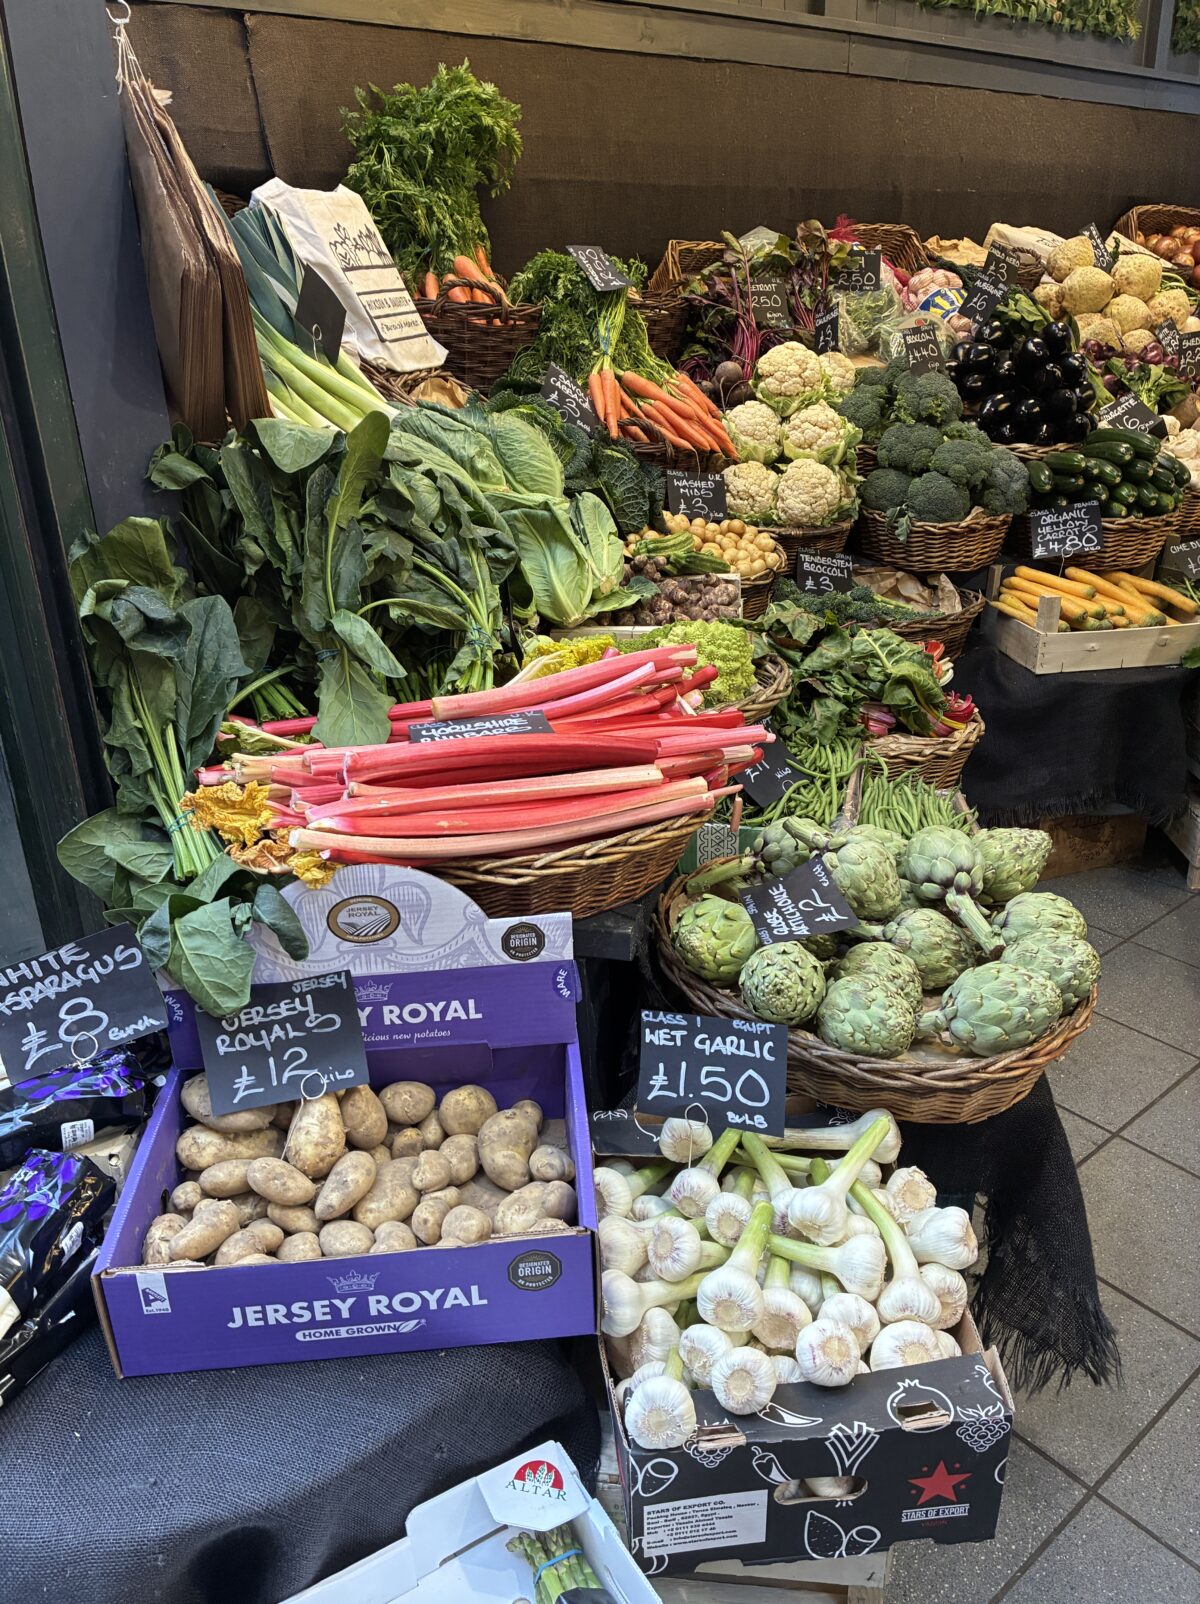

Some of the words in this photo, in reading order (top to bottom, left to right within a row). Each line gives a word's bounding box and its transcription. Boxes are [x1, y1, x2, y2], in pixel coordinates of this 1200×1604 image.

[986, 260, 1008, 282] £3
[967, 292, 989, 311] £6
[546, 390, 580, 418] £3
[673, 479, 715, 489] WASHED
[680, 488, 713, 498] MIDS
[678, 498, 709, 515] £3
[1040, 508, 1090, 525] ORGANIC
[1037, 519, 1089, 535] YELLOW
[1037, 524, 1098, 543] CARROTS
[800, 554, 853, 571] TENDERSTEM
[803, 562, 848, 579] BROCCOLI
[805, 576, 834, 591] £3
[421, 717, 529, 736] YORKSHIRE
[346, 905, 379, 913] JERSEY
[348, 910, 380, 918] ROYAL
[798, 888, 849, 923] £2
[509, 937, 538, 948] ORIGIN
[292, 972, 347, 993] JERSEY
[556, 968, 571, 998] WARE
[165, 995, 182, 1023] WARE
[221, 994, 314, 1032] JERSEY
[382, 999, 483, 1026] ROYAL
[641, 1010, 688, 1026] CLASS
[732, 1019, 776, 1035] EGYPT
[21, 997, 109, 1070] £8
[216, 1013, 341, 1056] ROYALS
[393, 1033, 411, 1041] new
[414, 1028, 451, 1043] potatoes
[645, 1028, 688, 1047] WET
[694, 1033, 776, 1062] GARLIC
[232, 1047, 318, 1104] £12
[647, 1061, 770, 1108] £1.50
[518, 1265, 552, 1277] ORIGIN
[227, 1297, 356, 1329] JERSEY
[367, 1285, 488, 1316] ROYAL
[302, 1328, 342, 1340] HOME
[345, 1323, 397, 1337] GROWN
[505, 1480, 567, 1501] ALTAR
[647, 1507, 670, 1515] STARS
[683, 1501, 712, 1510] EXPORT
[901, 1511, 926, 1521] STARS
[927, 1509, 938, 1518] OF
[939, 1506, 969, 1517] EXPORT
